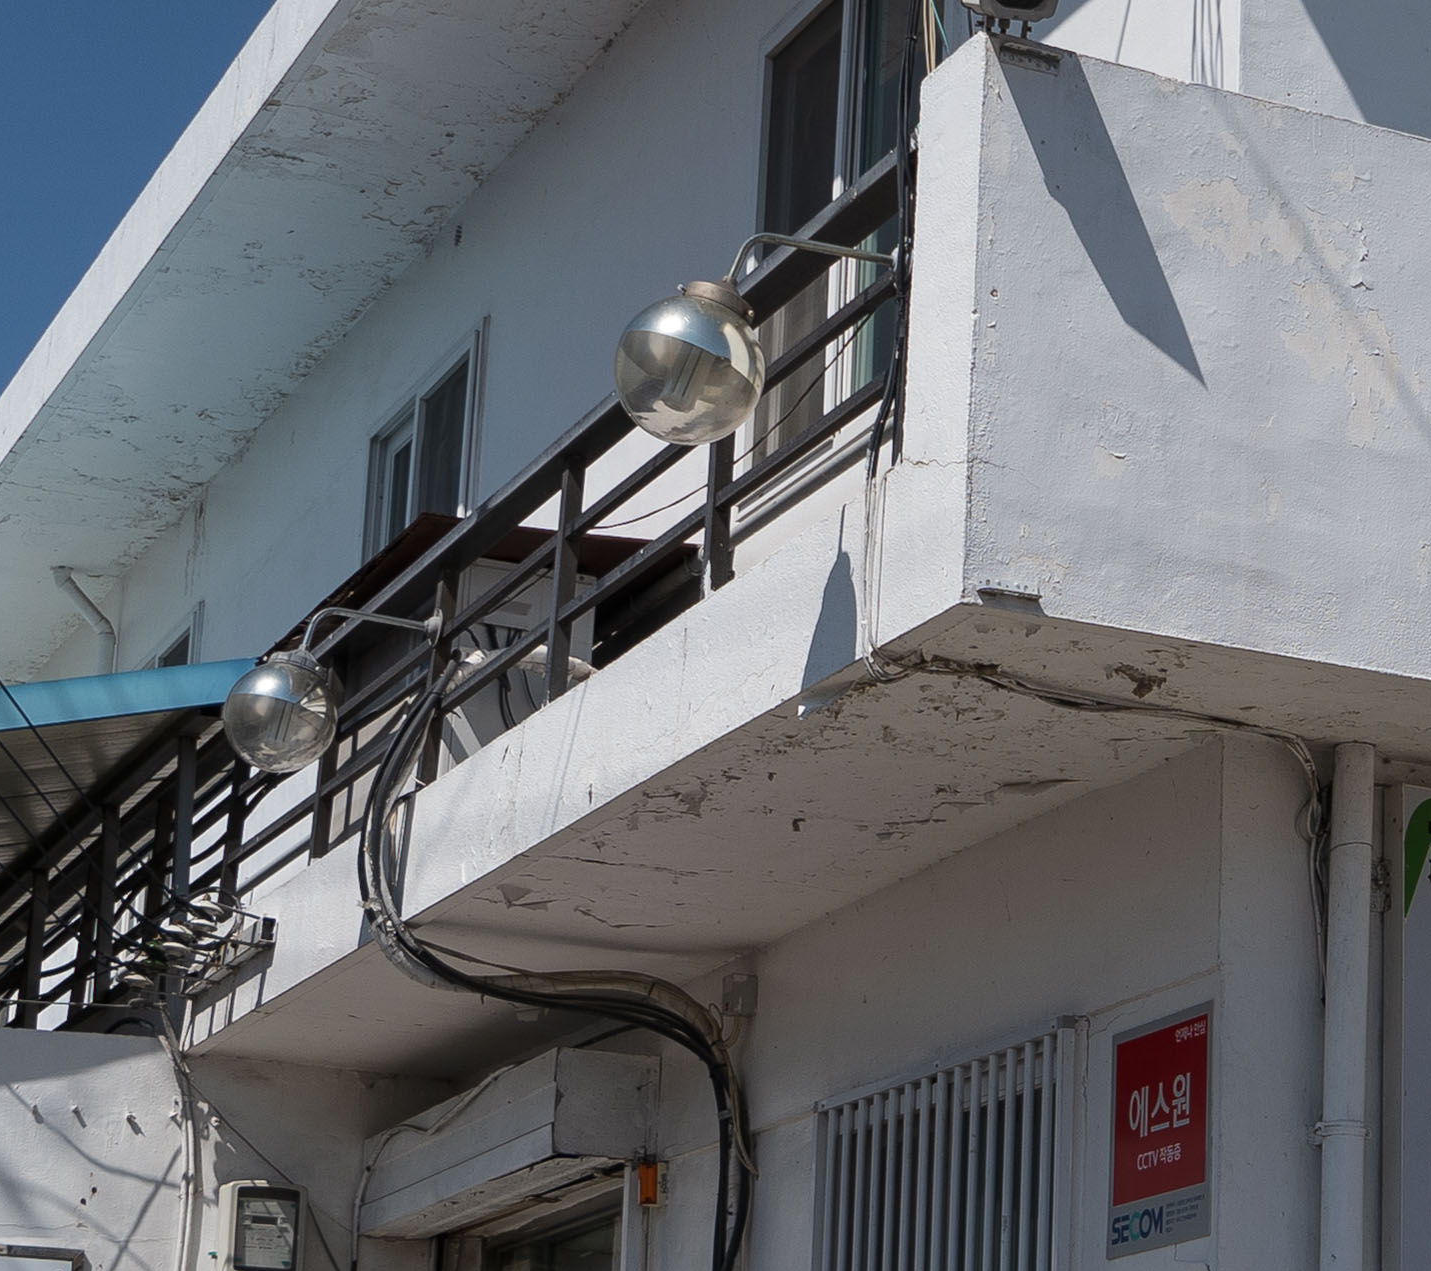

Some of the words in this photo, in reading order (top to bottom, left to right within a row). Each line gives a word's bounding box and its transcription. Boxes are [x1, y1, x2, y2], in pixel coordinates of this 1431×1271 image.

[1129, 1072, 1191, 1138] 에스원
[1137, 1150, 1159, 1171] CCTV
[1159, 1143, 1182, 1164] 작동중
[1112, 1205, 1164, 1245] SECOM
